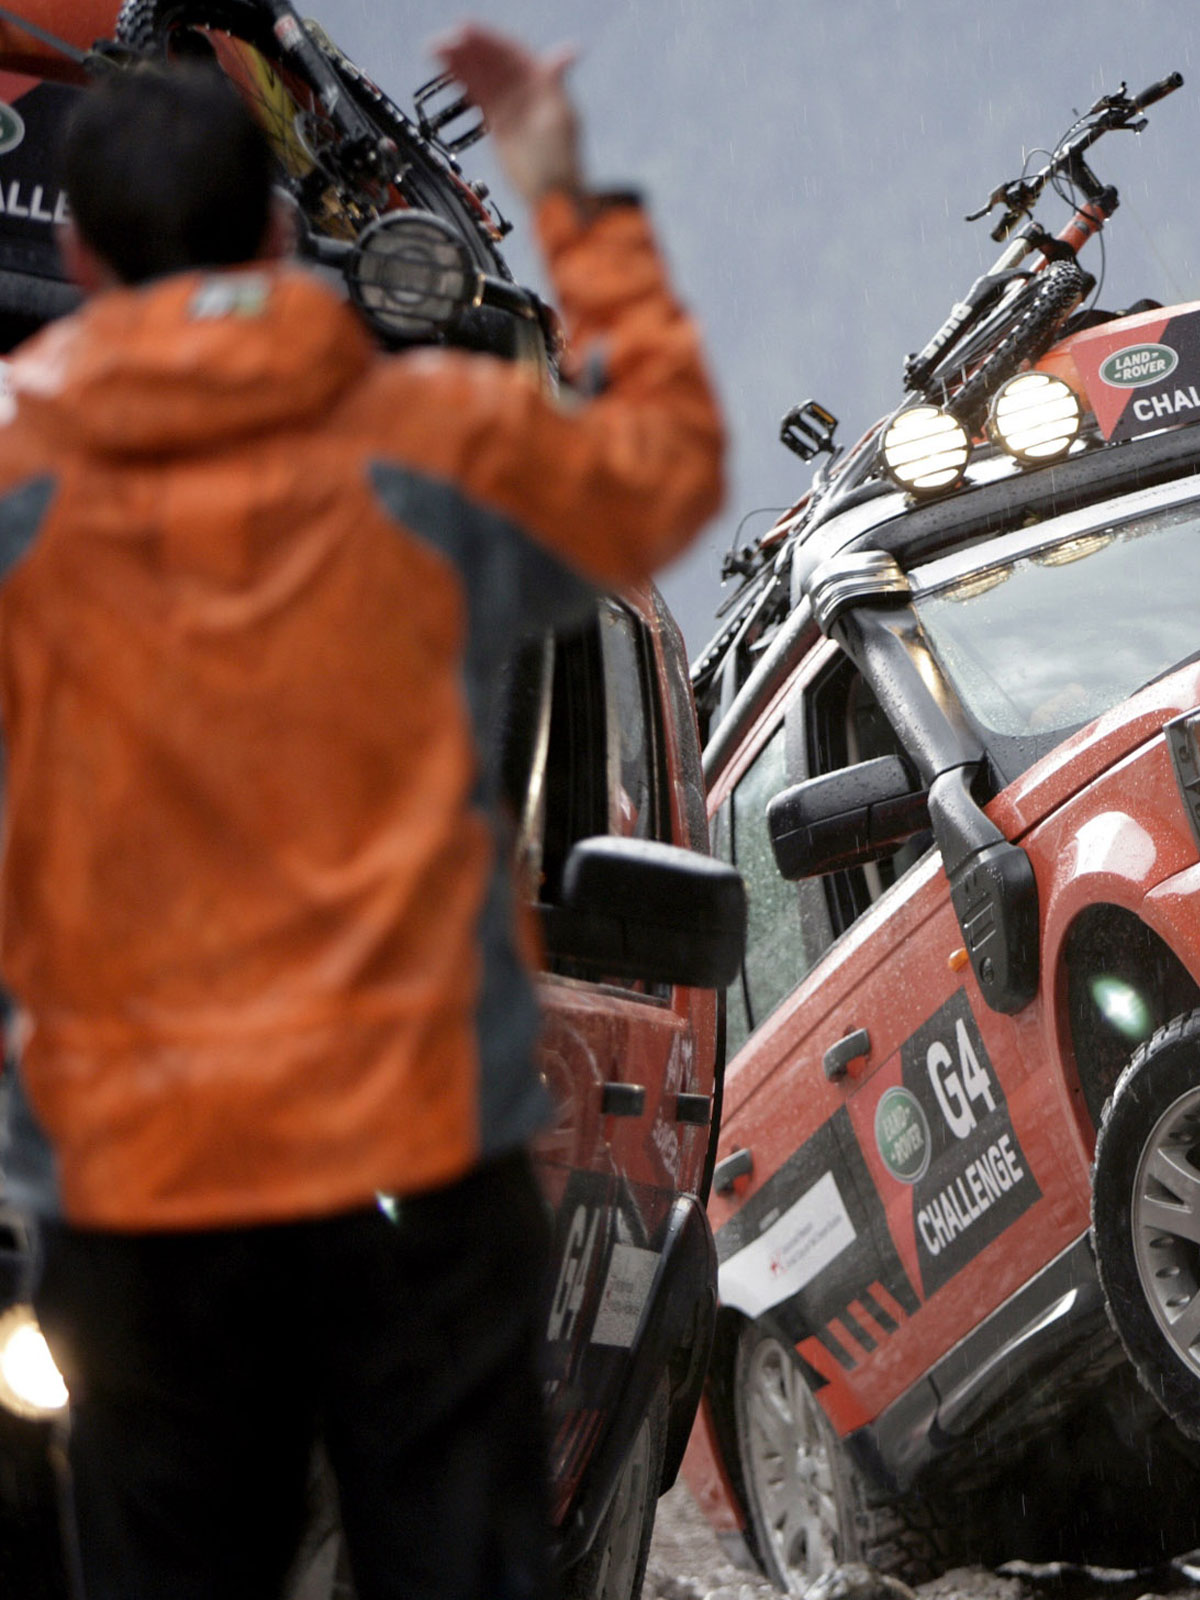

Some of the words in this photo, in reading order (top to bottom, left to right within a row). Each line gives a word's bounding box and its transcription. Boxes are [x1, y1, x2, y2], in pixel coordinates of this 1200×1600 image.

[1115, 351, 1150, 370] LAND
[1122, 359, 1166, 380] ROVER
[927, 1018, 996, 1139] G4
[893, 1123, 925, 1166] ROVER
[917, 1134, 1024, 1256] CHALLENGE
